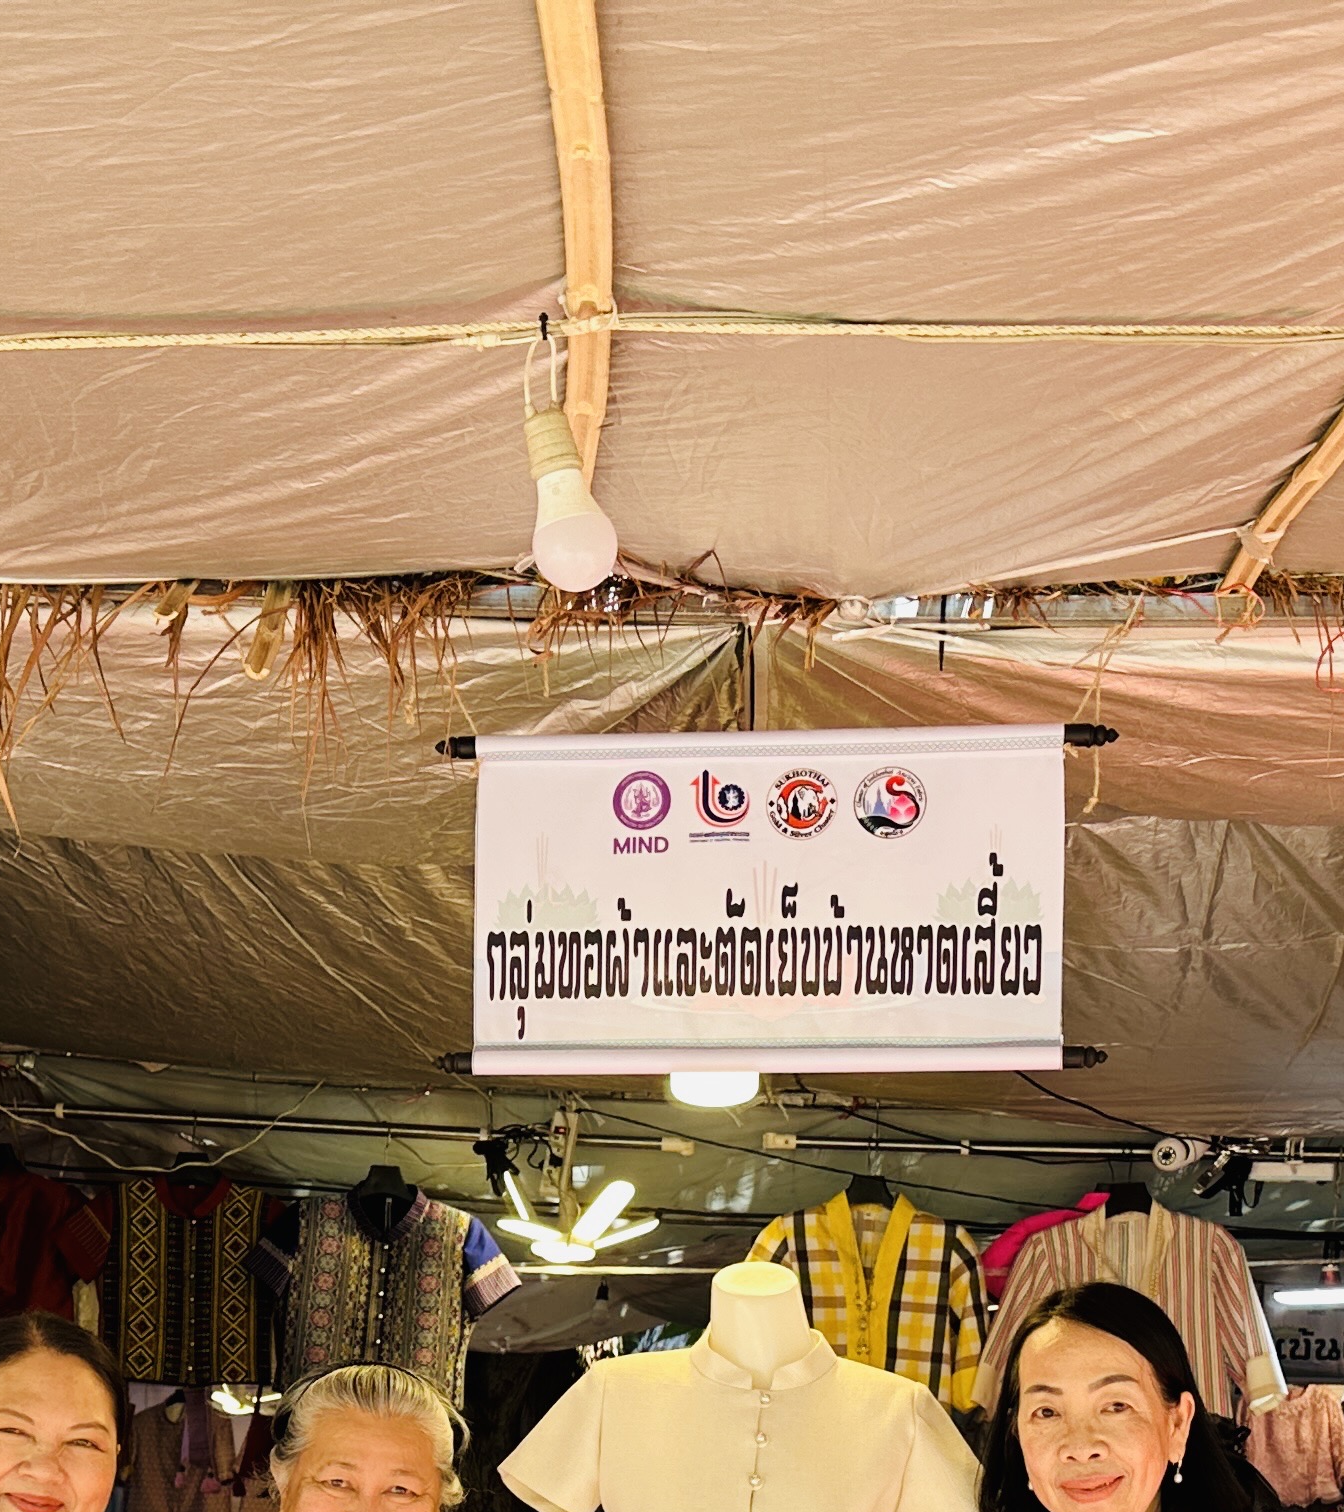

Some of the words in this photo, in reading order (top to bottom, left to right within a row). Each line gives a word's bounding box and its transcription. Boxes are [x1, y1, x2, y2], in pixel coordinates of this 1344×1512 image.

[613, 836, 669, 855] MIND
[487, 852, 1042, 1040] กลุ่มทอผ้าและตัดเย็บบ้านหาดเสี้ยว
